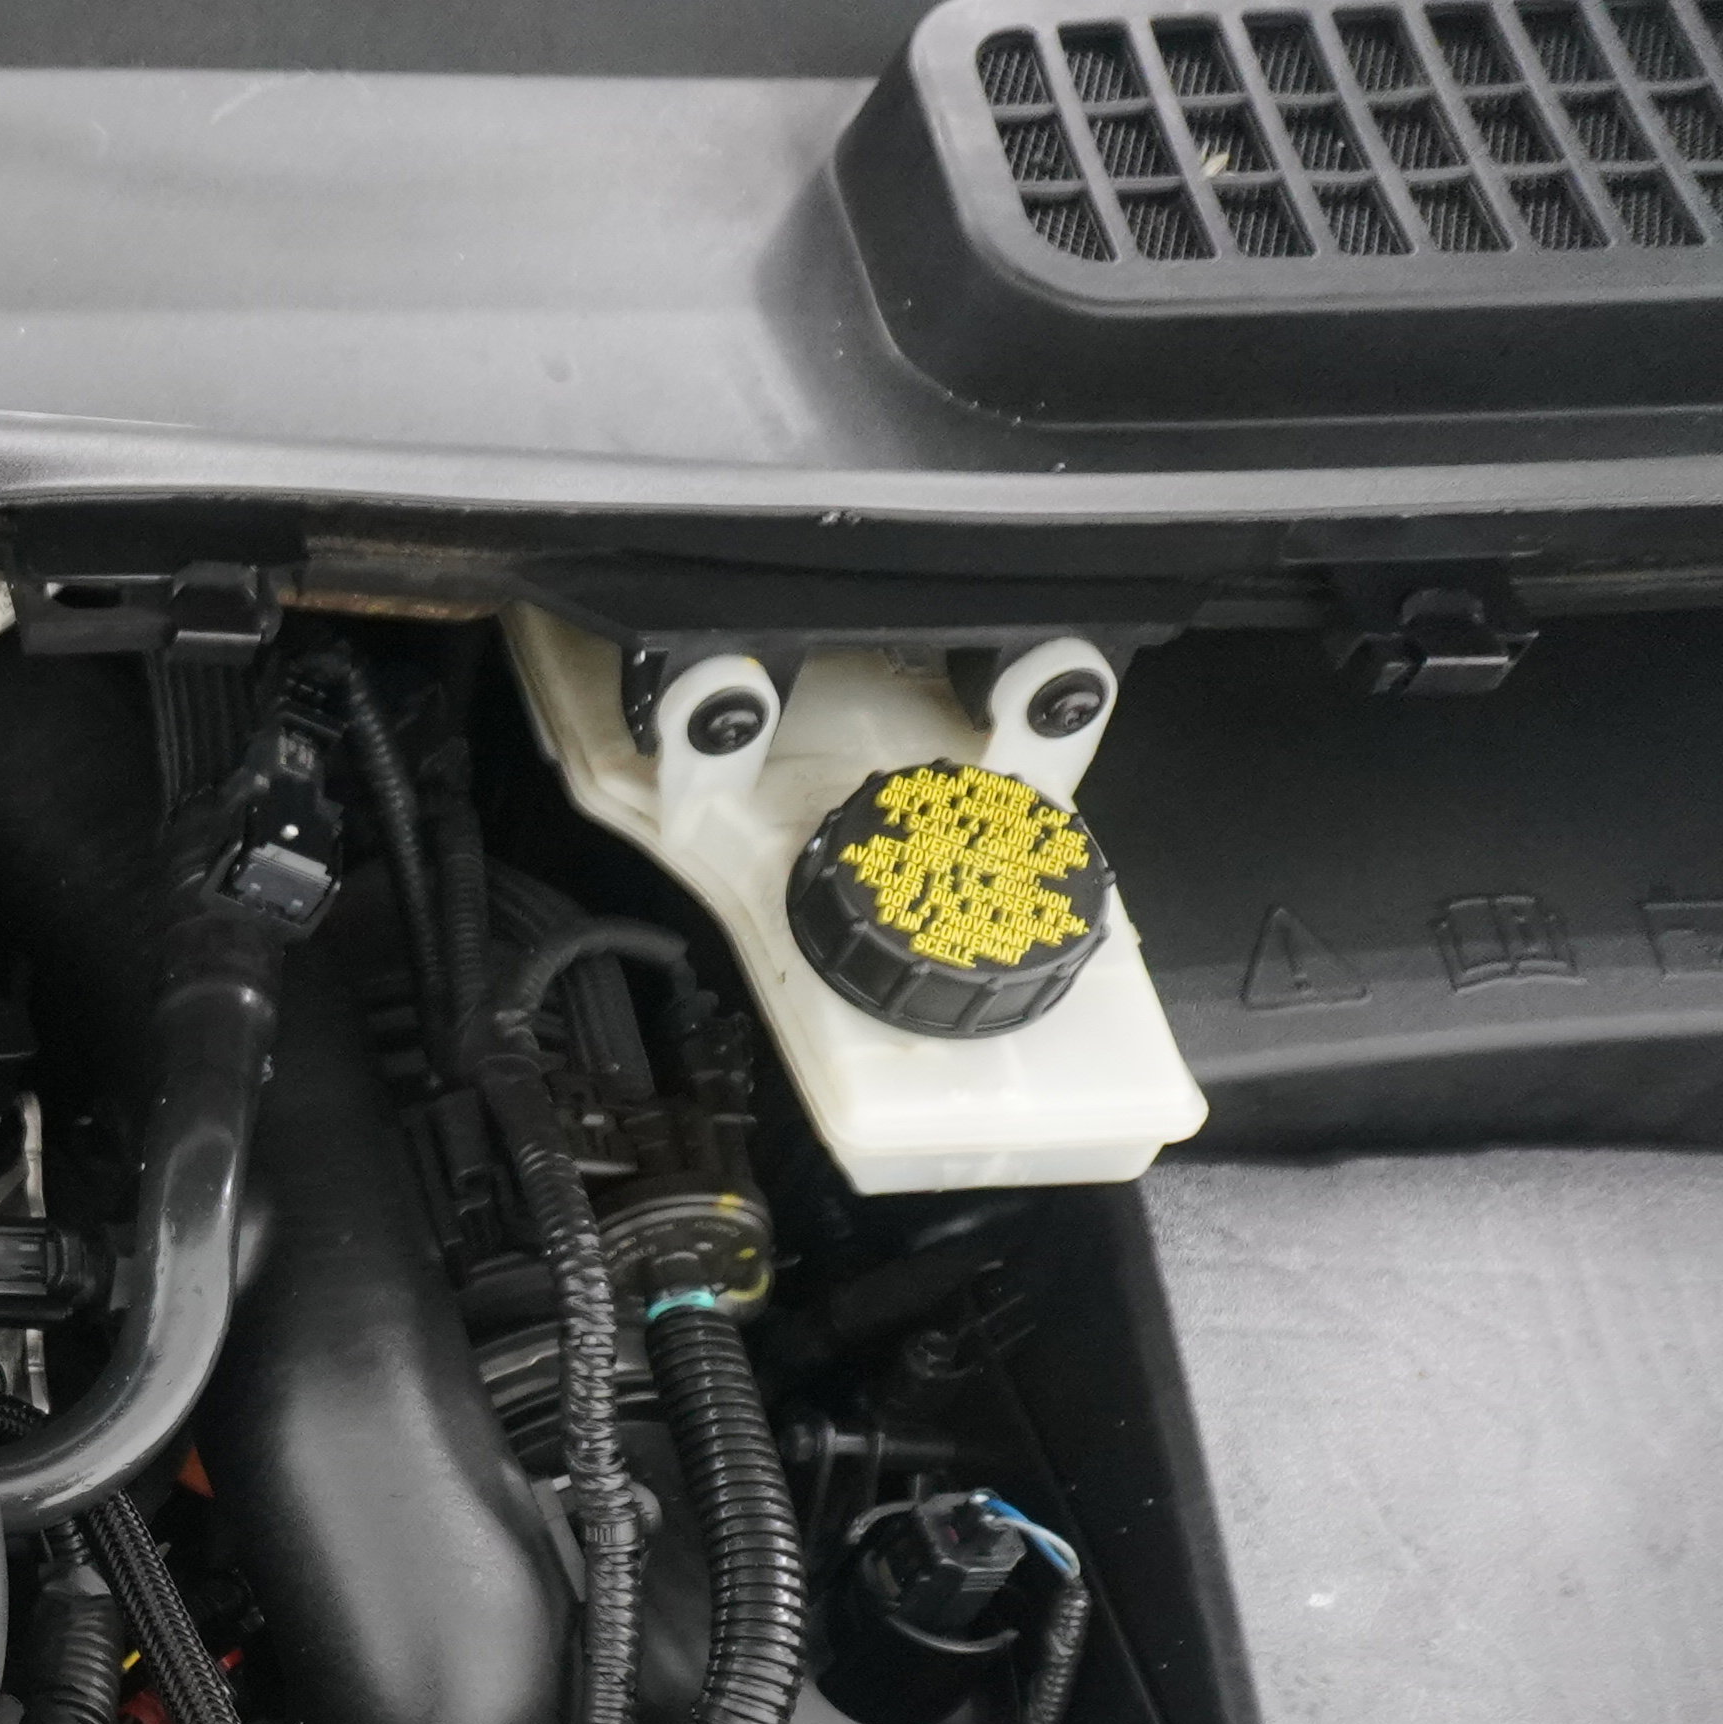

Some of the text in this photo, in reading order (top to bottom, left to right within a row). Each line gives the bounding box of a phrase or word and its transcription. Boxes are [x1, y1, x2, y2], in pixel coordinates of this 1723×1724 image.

[881, 787, 1088, 868] ONLY DOT 4 FLUID FROM
[889, 806, 901, 824] A
[910, 813, 969, 845] SEALED
[892, 774, 951, 807] BEFORE
[1055, 828, 1086, 850] USE
[917, 767, 1070, 828] CLEAN FILLER CAP
[845, 842, 896, 872] AVANT
[906, 862, 926, 882] DE
[935, 871, 954, 891] LE
[870, 834, 1070, 911] NETTOYER LE BOUCHON
[861, 864, 1064, 944] PLOYER QUE DU LIQUIDE
[881, 888, 1033, 951] DOT 4 PROVENANT
[883, 905, 1023, 965] D'UN CONTENANT
